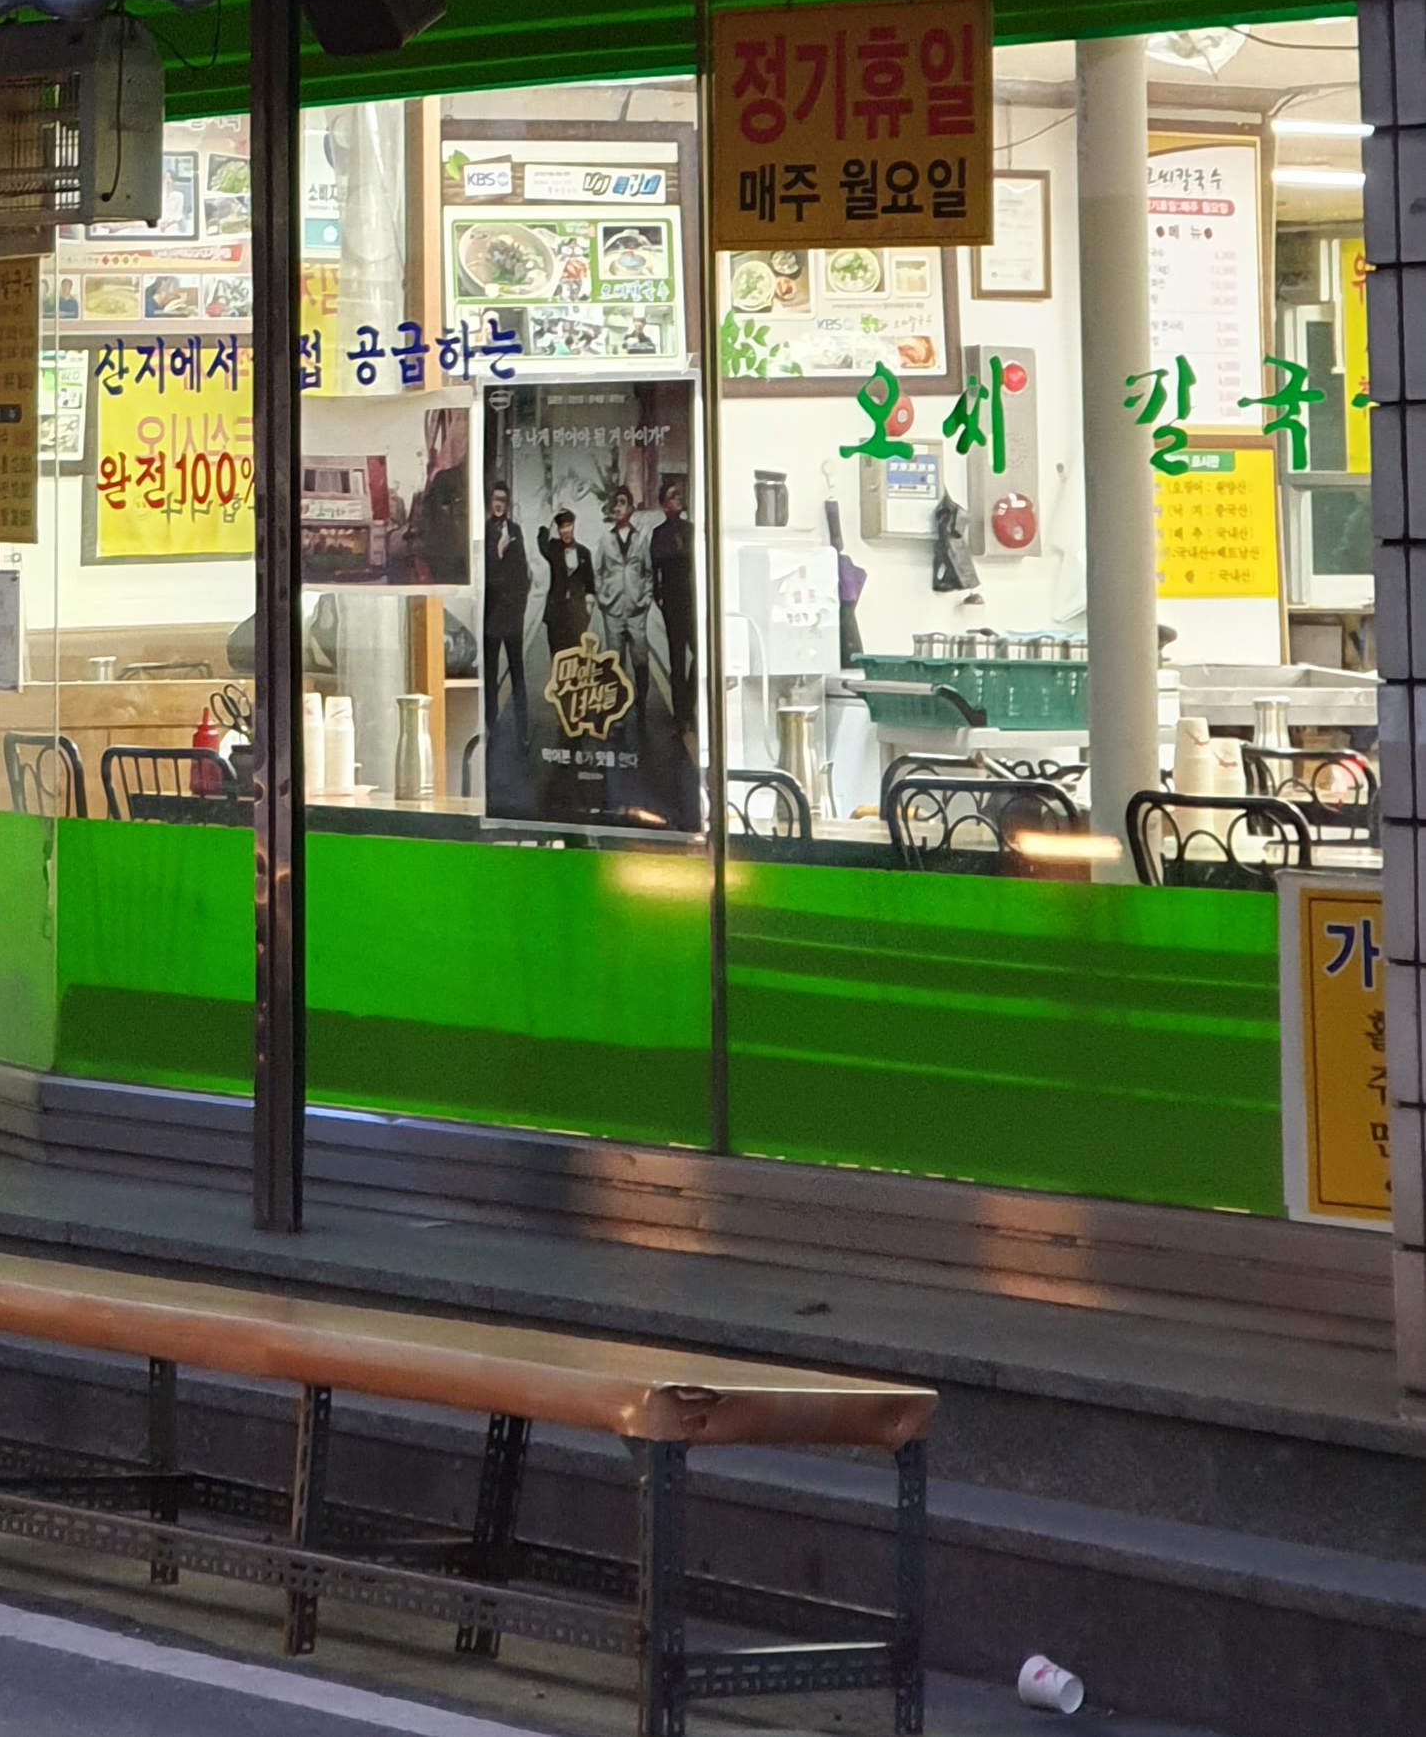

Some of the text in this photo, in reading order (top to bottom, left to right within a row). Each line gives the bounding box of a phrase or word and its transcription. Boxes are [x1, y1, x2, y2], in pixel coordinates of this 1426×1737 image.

[733, 24, 976, 145] 정기휴일
[467, 172, 496, 187] KBS
[739, 158, 968, 223] 매주 월요일
[94, 335, 238, 395] 산지에서
[346, 318, 523, 386] 공급하는
[1124, 354, 1371, 475] 칼국
[1325, 918, 1380, 990] 가
